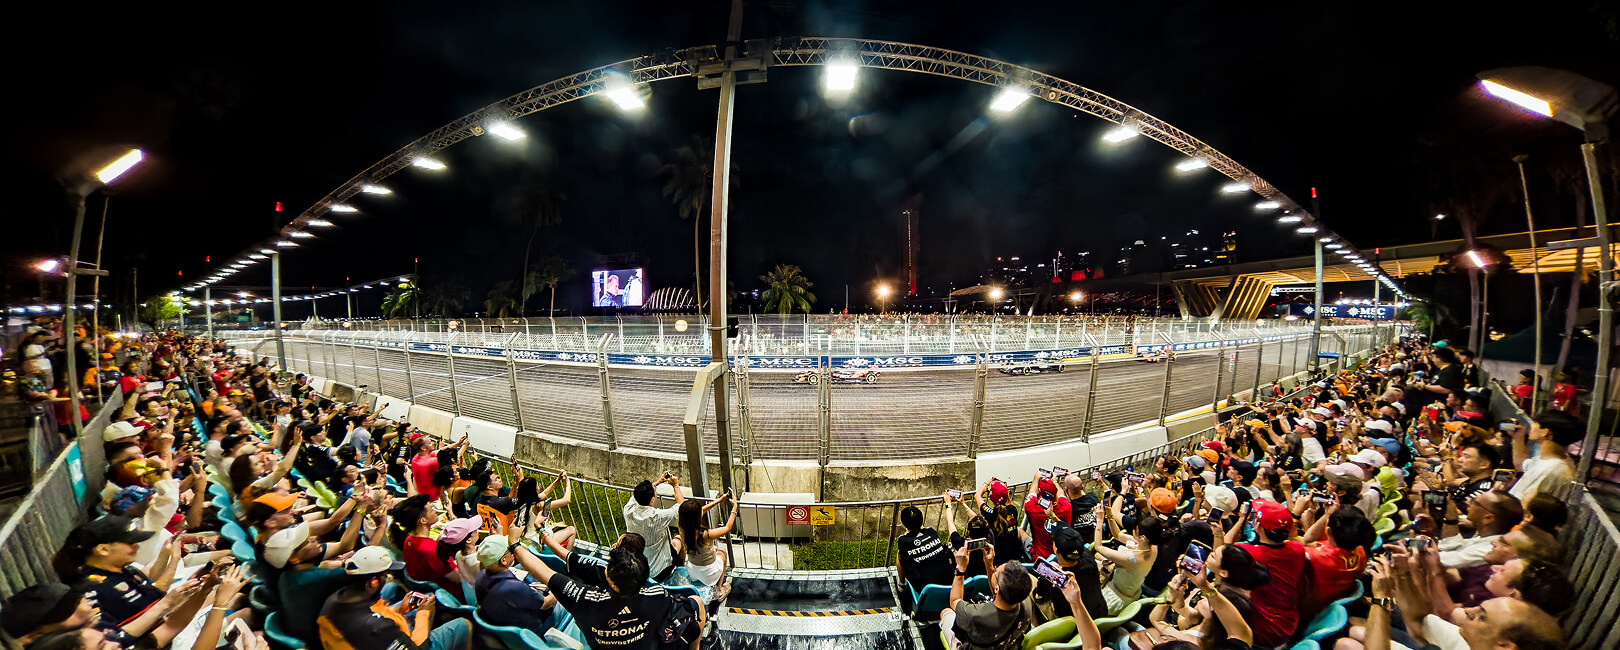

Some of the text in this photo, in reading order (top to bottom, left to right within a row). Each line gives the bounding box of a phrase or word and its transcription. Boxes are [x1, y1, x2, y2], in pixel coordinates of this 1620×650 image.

[1320, 306, 1337, 314] SC
[1360, 307, 1385, 315] MSC
[655, 356, 701, 364] MSC
[873, 357, 923, 365] MSC
[591, 620, 650, 638] PETRONAS
